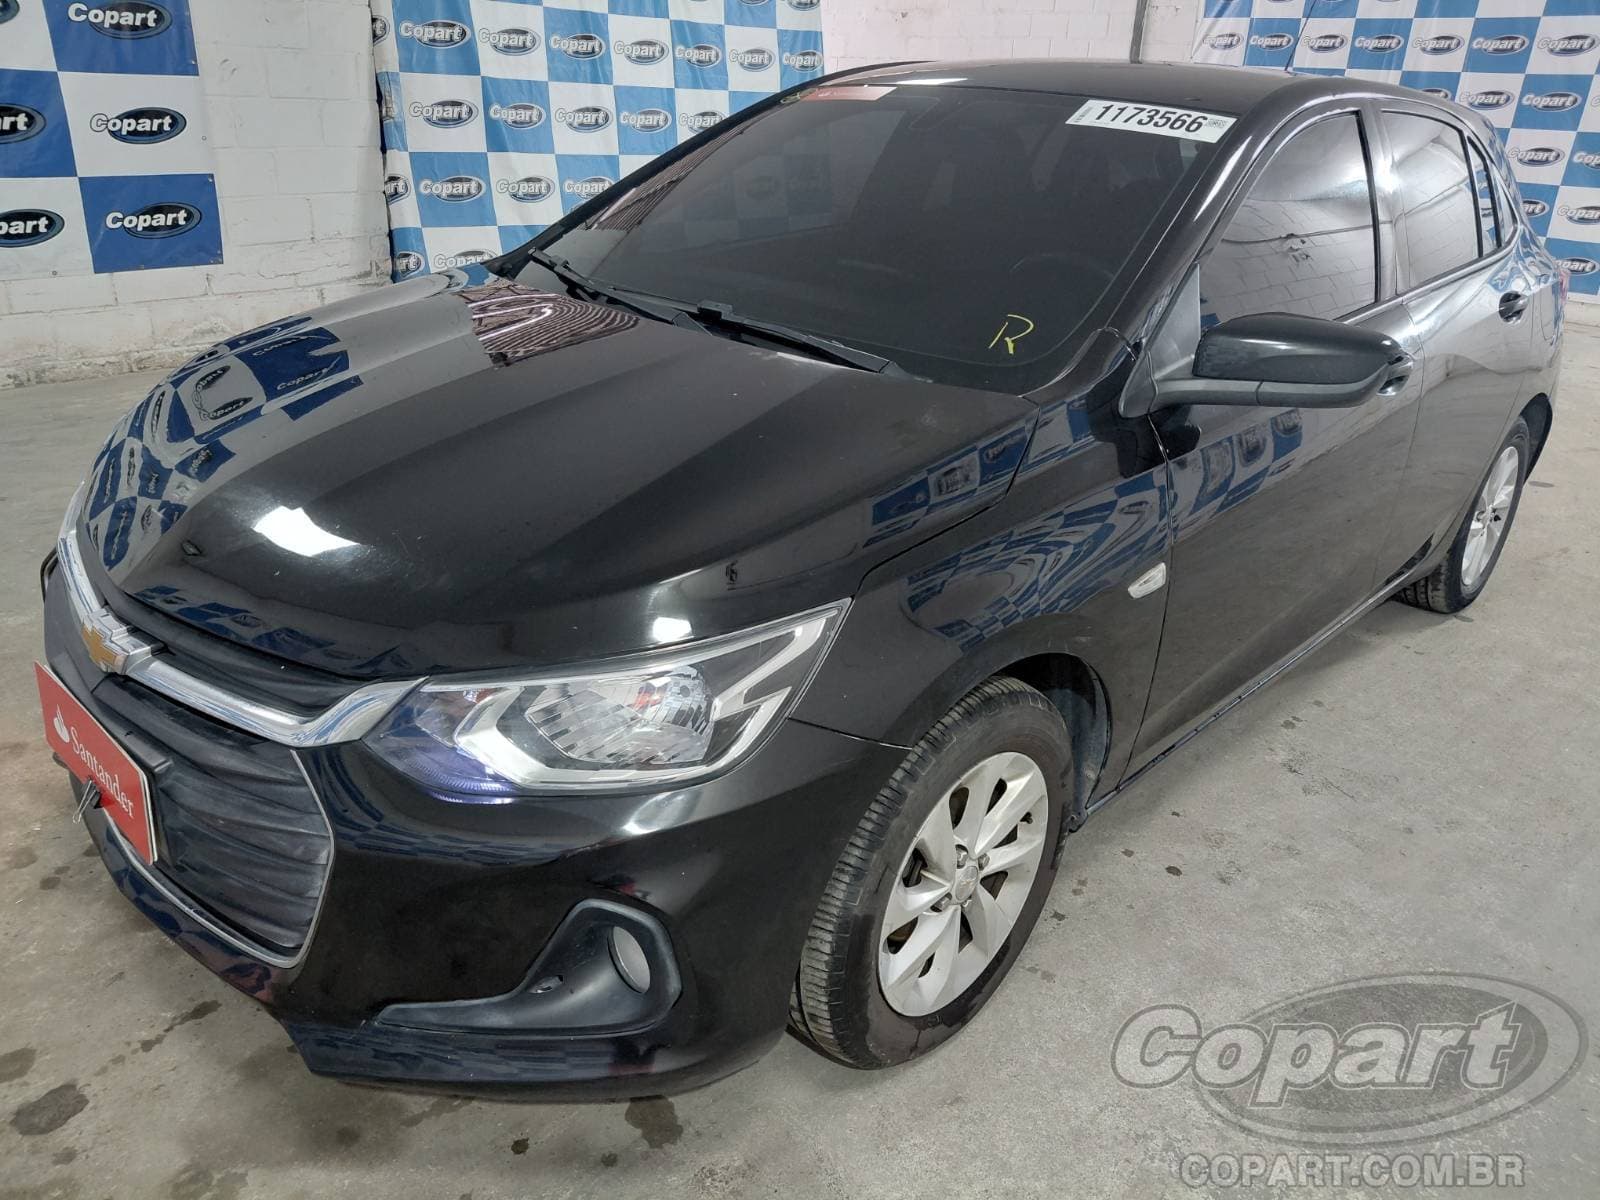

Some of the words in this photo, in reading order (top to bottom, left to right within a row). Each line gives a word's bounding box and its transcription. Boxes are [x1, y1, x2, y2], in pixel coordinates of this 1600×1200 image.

[68, 3, 157, 27] Copart
[401, 21, 461, 41] Copart
[479, 28, 533, 47] Copart
[551, 36, 600, 53] Copart
[615, 41, 661, 59] Copart
[1250, 35, 1288, 48] Copart
[1304, 35, 1341, 48] Copart
[1355, 36, 1398, 50] Copart
[1412, 38, 1459, 51] Copart
[1472, 38, 1524, 51] Copart
[1537, 37, 1593, 51] Copart
[676, 46, 716, 62] Copart
[730, 50, 769, 65] Copart
[783, 53, 818, 68] Copart
[1460, 91, 1509, 104] Copart
[1521, 93, 1574, 107] Copart
[409, 102, 469, 120] Copart
[490, 105, 538, 123] Copart
[555, 108, 606, 127] Copart
[1096, 104, 1208, 133] 1173566
[91, 113, 171, 134] Copart
[621, 112, 666, 128] Copart
[1507, 148, 1558, 162] Copart
[419, 179, 478, 197] Copart
[496, 179, 547, 197] Copart
[1557, 204, 1600, 220] Copar
[0, 216, 49, 235] part
[106, 211, 187, 231] Copart
[988, 314, 1034, 354] R
[70, 726, 134, 818] Santander
